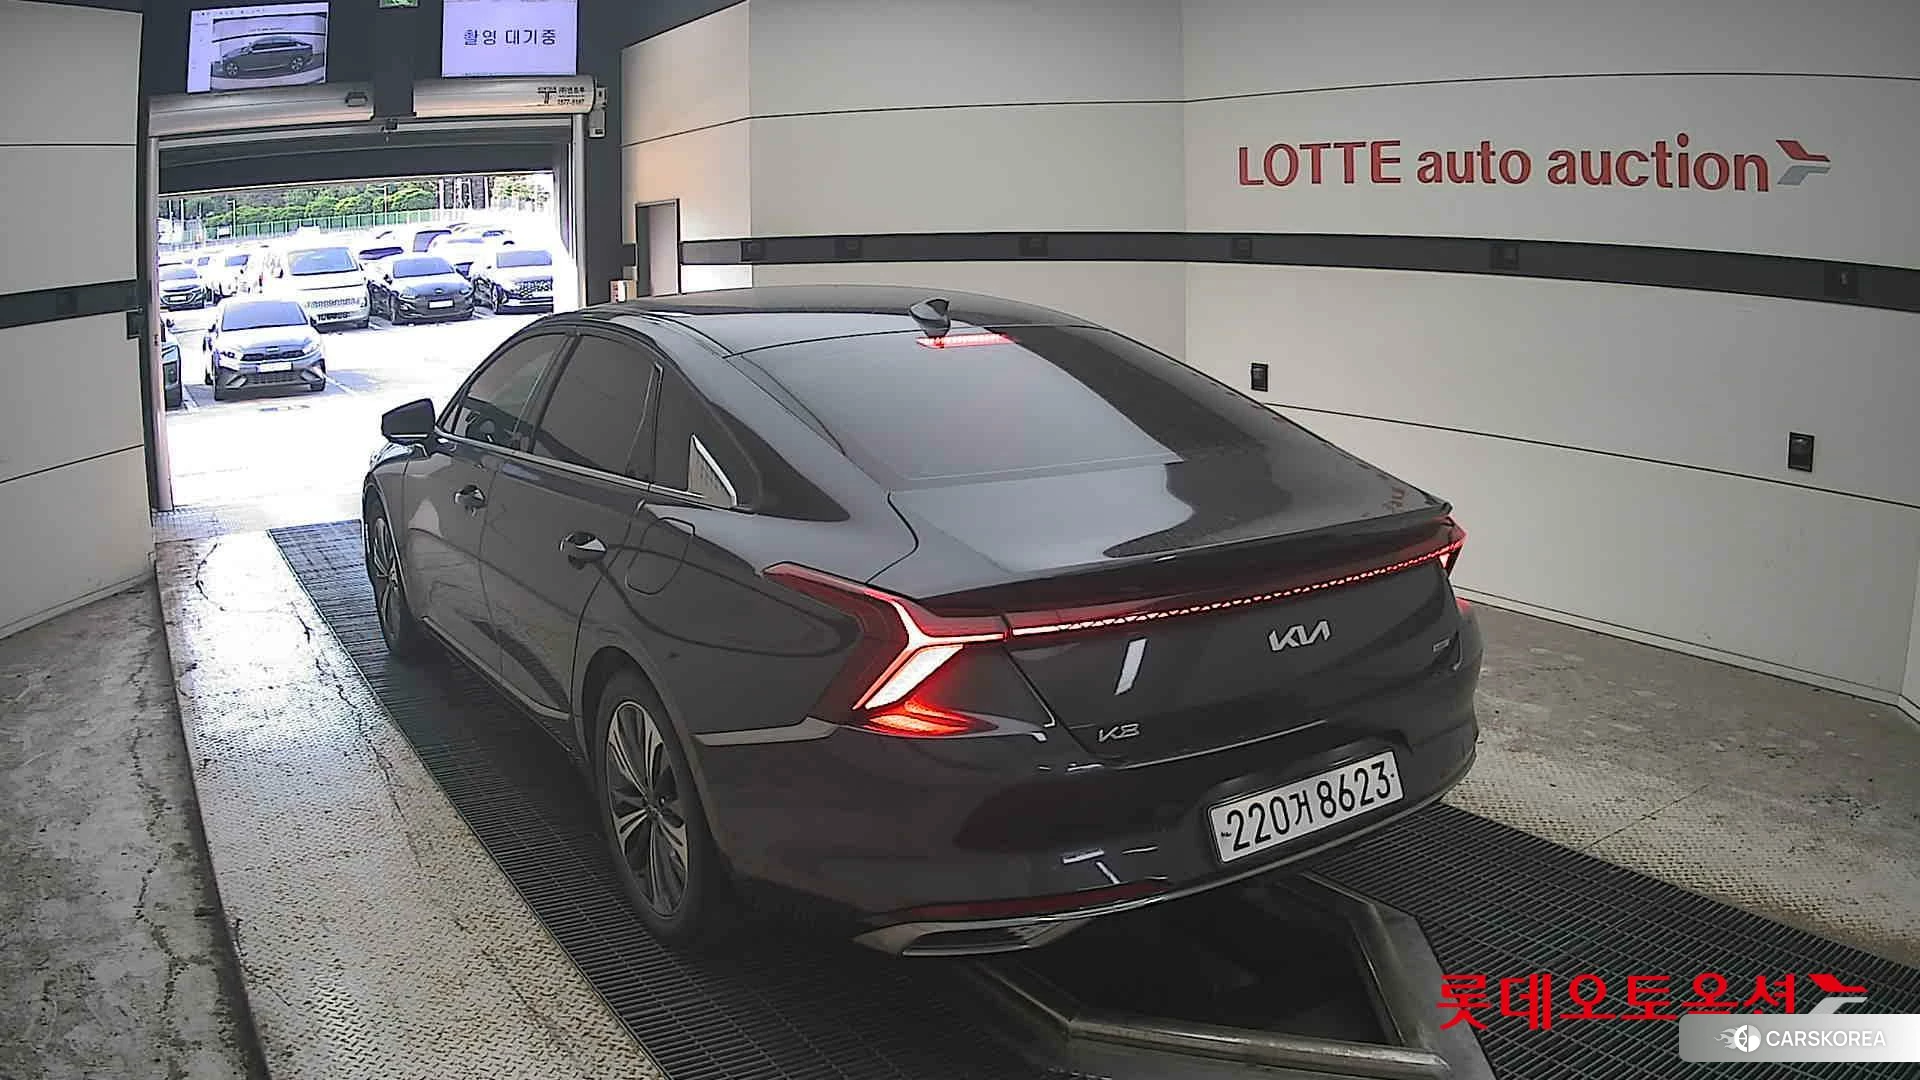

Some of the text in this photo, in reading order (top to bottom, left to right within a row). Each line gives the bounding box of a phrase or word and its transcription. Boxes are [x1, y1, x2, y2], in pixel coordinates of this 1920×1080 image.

[505, 29, 556, 46] 대기중
[1238, 133, 1769, 192] LOTTE auto auction
[1268, 620, 1331, 651] KIA
[1098, 722, 1141, 743] K8
